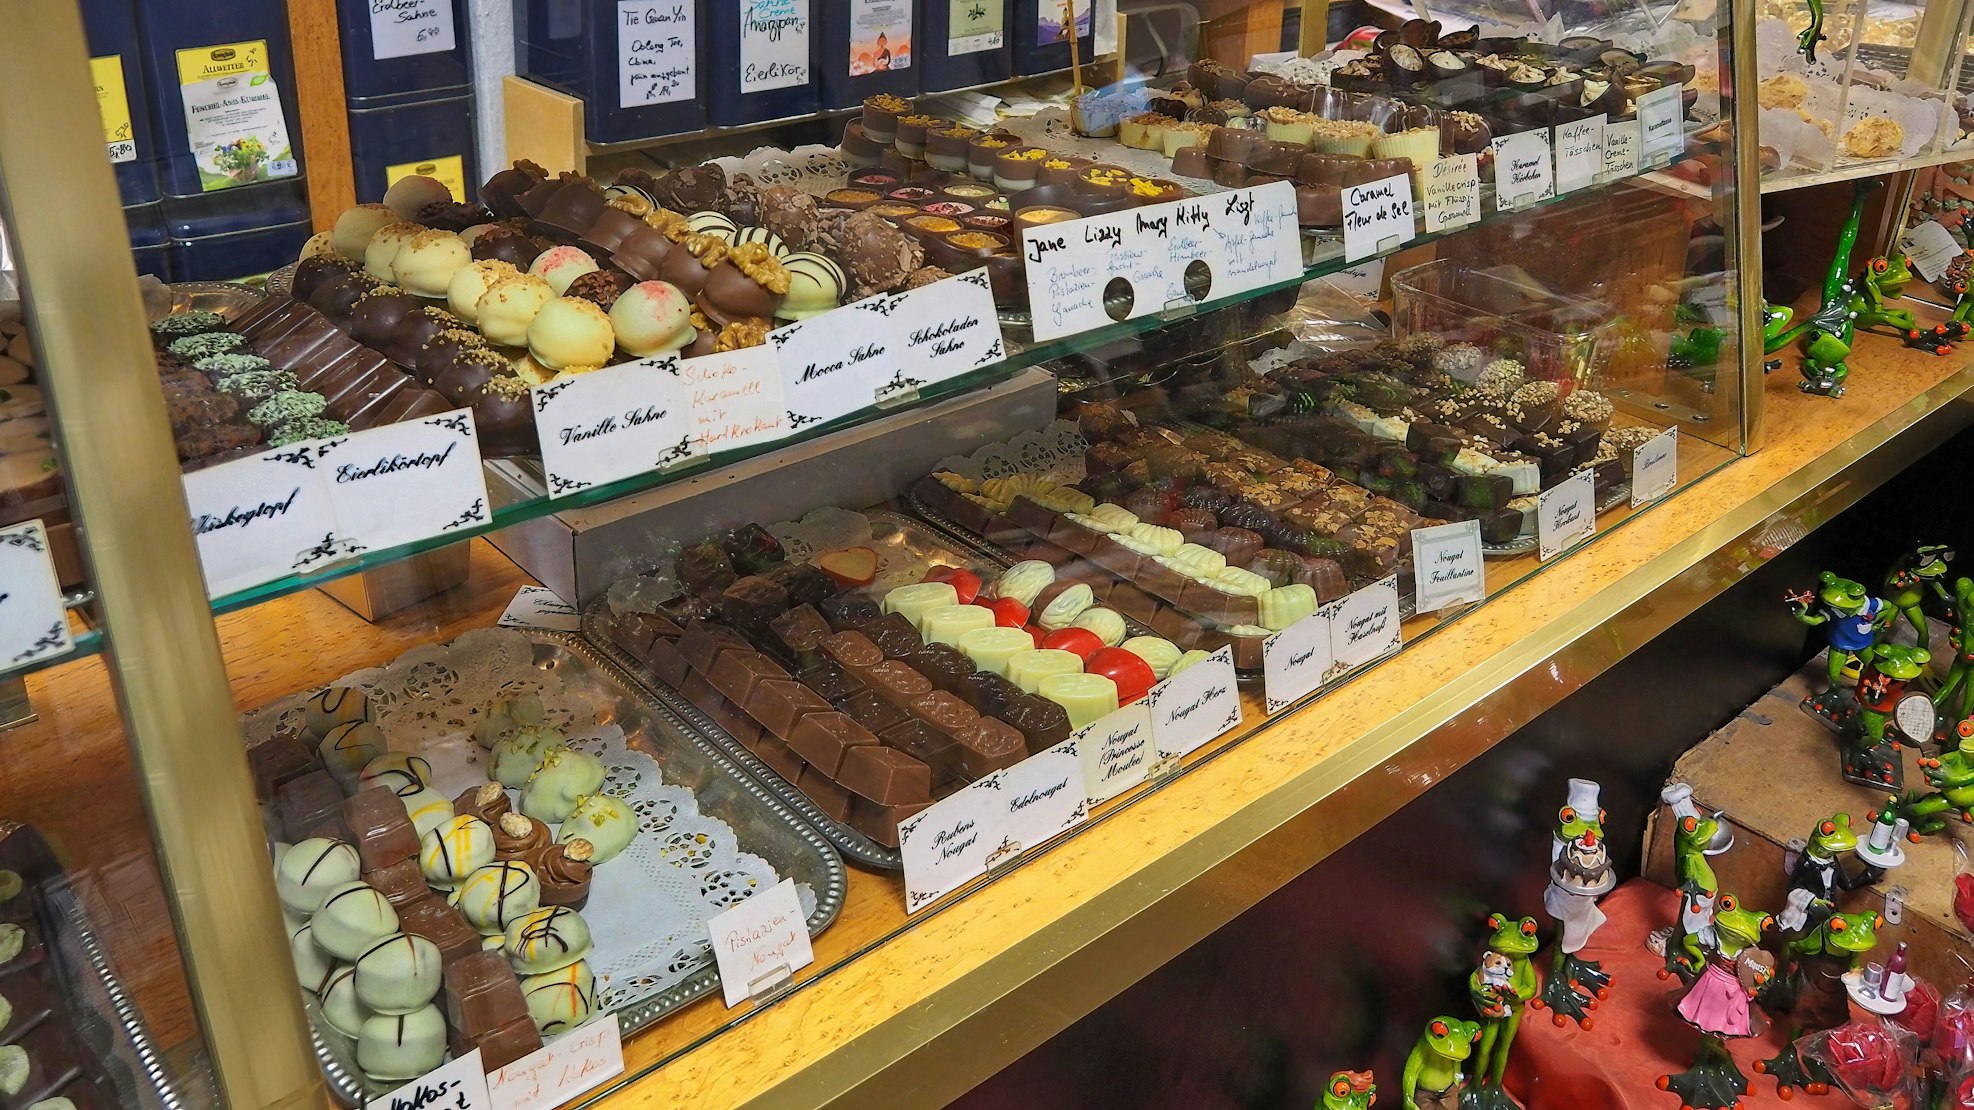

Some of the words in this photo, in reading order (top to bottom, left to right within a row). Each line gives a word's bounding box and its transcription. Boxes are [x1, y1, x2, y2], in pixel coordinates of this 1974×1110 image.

[393, 9, 437, 23] Sahne
[623, 11, 640, 25] Tie
[673, 5, 687, 23] Yin
[760, 8, 796, 19] Creme
[1562, 126, 1595, 142] Kaffee-
[1607, 134, 1632, 147] Vanille-
[1564, 144, 1602, 158] Tässchen
[1605, 148, 1630, 159] Creme-
[1433, 158, 1467, 178] Désirée
[1350, 182, 1395, 207] Caramel
[1428, 199, 1441, 210] mit
[1027, 237, 1066, 263] Jane
[1085, 224, 1122, 248] Lizzy
[1176, 203, 1209, 231] Kitty
[1225, 192, 1255, 226] Liszt
[1344, 210, 1372, 231] Fleur
[1376, 207, 1387, 221] de
[908, 316, 979, 347] Schokoladen
[929, 340, 965, 359] Sahne
[795, 360, 844, 385] Mocca
[847, 343, 886, 366] Sahne
[560, 415, 617, 446] Vanille
[621, 404, 668, 429] Sahne
[336, 441, 457, 484] Eierlikörtopf
[1552, 510, 1581, 532] Krokant
[1554, 500, 1578, 519] Nougat
[1434, 549, 1465, 565] Nougat
[1429, 568, 1474, 585] Feuillantine
[1344, 610, 1373, 633] Nougat
[1374, 605, 1388, 621] mit
[1347, 618, 1387, 646] Haselnuß
[1284, 647, 1315, 671] Nougat
[1165, 697, 1201, 726] Nougat
[1202, 685, 1227, 705] Herz
[1101, 722, 1140, 751] Nougat
[1010, 777, 1069, 813] Edelnougat
[931, 819, 975, 850] Rubens
[935, 832, 978, 866] Nougat
[750, 931, 797, 972] Nougat
